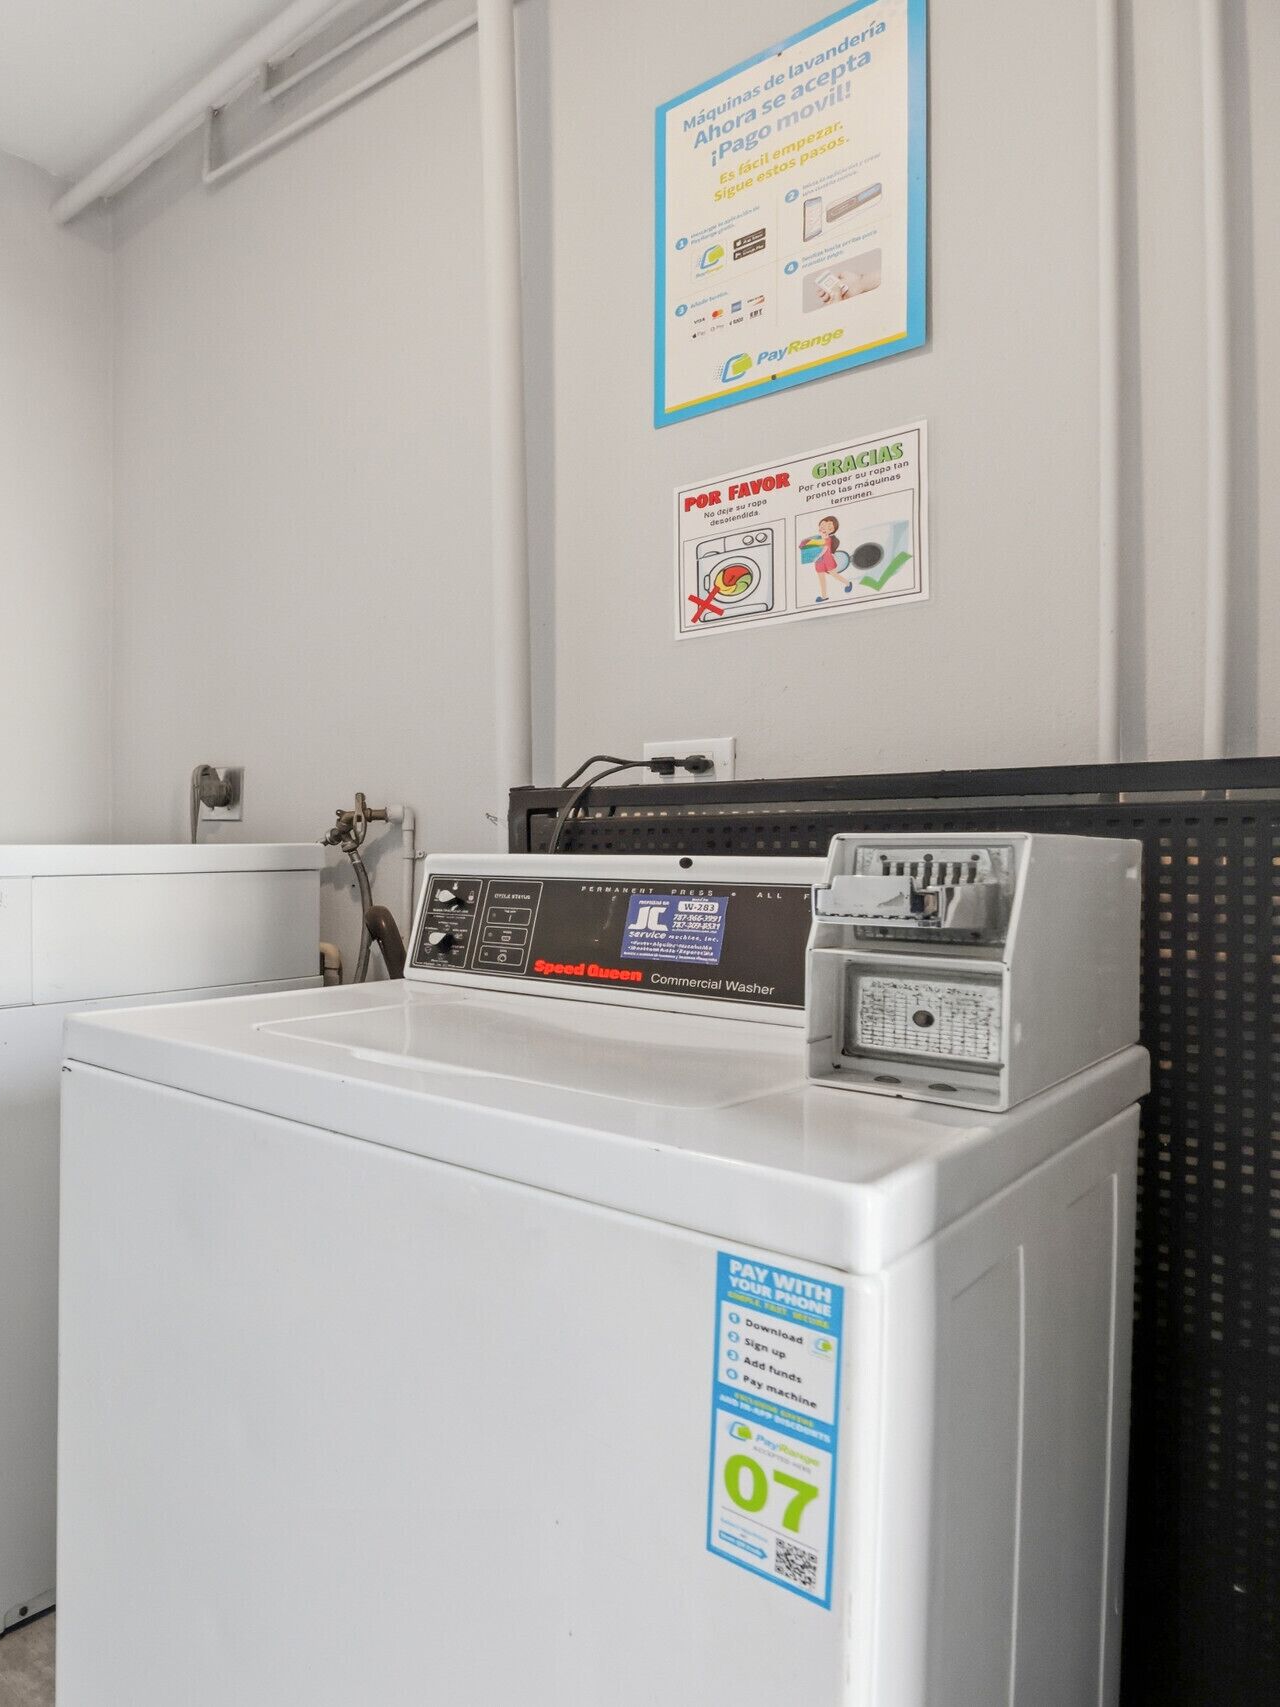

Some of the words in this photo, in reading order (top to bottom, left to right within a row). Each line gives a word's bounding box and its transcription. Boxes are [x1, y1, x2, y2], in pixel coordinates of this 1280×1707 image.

[683, 82, 761, 132] Máquinas
[763, 73, 785, 92] de
[787, 20, 887, 79] lavandería
[693, 108, 757, 149] Ahora
[761, 92, 786, 115] se
[790, 50, 872, 100] acepta
[710, 123, 772, 167] ¡Pago
[719, 170, 736, 185] Es
[737, 154, 770, 176] fácil
[772, 119, 844, 160] empezar.
[713, 174, 753, 202] Sigue
[756, 156, 797, 183] estos
[799, 135, 850, 166] pasos.
[756, 327, 845, 366] PayRange
[798, 483, 814, 493] Por
[816, 475, 853, 489] recoger
[855, 472, 867, 481] su
[869, 465, 891, 478] ropa
[893, 460, 910, 470] tan
[811, 442, 904, 480] GRACIAS
[684, 490, 722, 512] POR
[728, 472, 791, 500] FAVOR
[806, 489, 836, 503] pronto
[838, 484, 853, 494] las
[854, 472, 901, 490] máquinas
[703, 511, 716, 519] No
[717, 507, 734, 518] deje
[736, 503, 746, 512] su
[747, 498, 768, 510] ropa
[581, 886, 655, 894] PERMANENT
[671, 888, 715, 897] PRESS
[685, 903, 715, 912] W-283
[628, 931, 667, 940] service
[534, 959, 585, 976] Speed
[587, 963, 643, 982] Queen
[650, 973, 721, 990] Commercial
[725, 980, 776, 996] Washer
[728, 1259, 769, 1283] PAY
[772, 1271, 833, 1303] WITH
[728, 1275, 773, 1299] YOUR
[775, 1289, 832, 1318] PHONE
[745, 1318, 804, 1345] Download
[745, 1338, 769, 1353] Sign
[772, 1347, 787, 1360] up
[744, 1356, 766, 1371] Add
[769, 1366, 802, 1384] funds
[743, 1375, 763, 1390] Pay
[766, 1385, 818, 1409] machine
[756, 1433, 820, 1467] PayRange
[724, 1454, 819, 1533] 07
